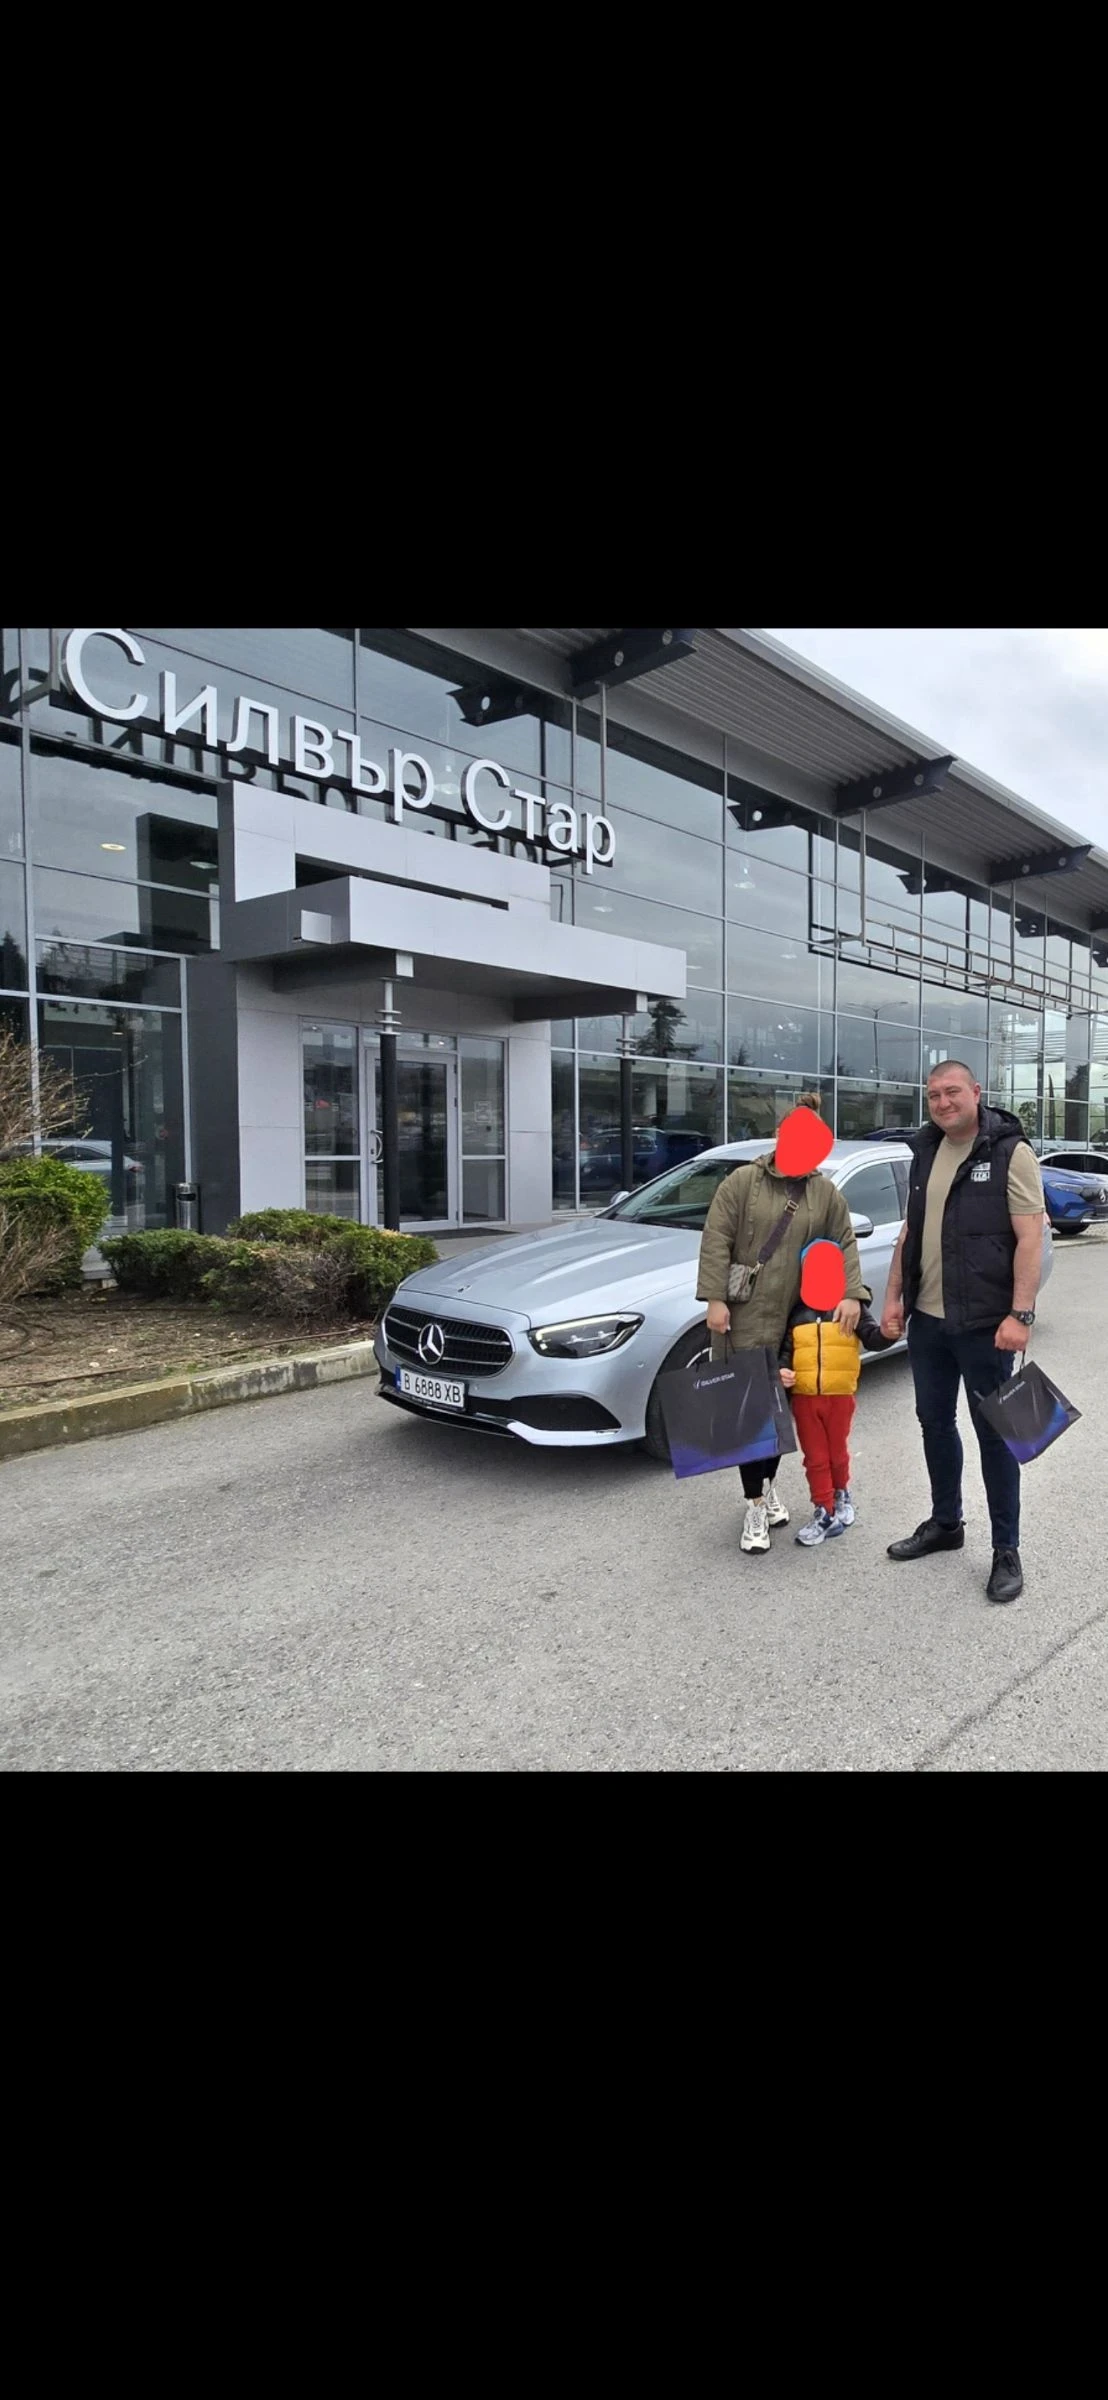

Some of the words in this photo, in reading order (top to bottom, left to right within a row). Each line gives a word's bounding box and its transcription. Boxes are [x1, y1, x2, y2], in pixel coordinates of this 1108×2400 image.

[61, 628, 435, 822] Силвър
[461, 759, 617, 875] Стар
[415, 1377, 442, 1399] 6888
